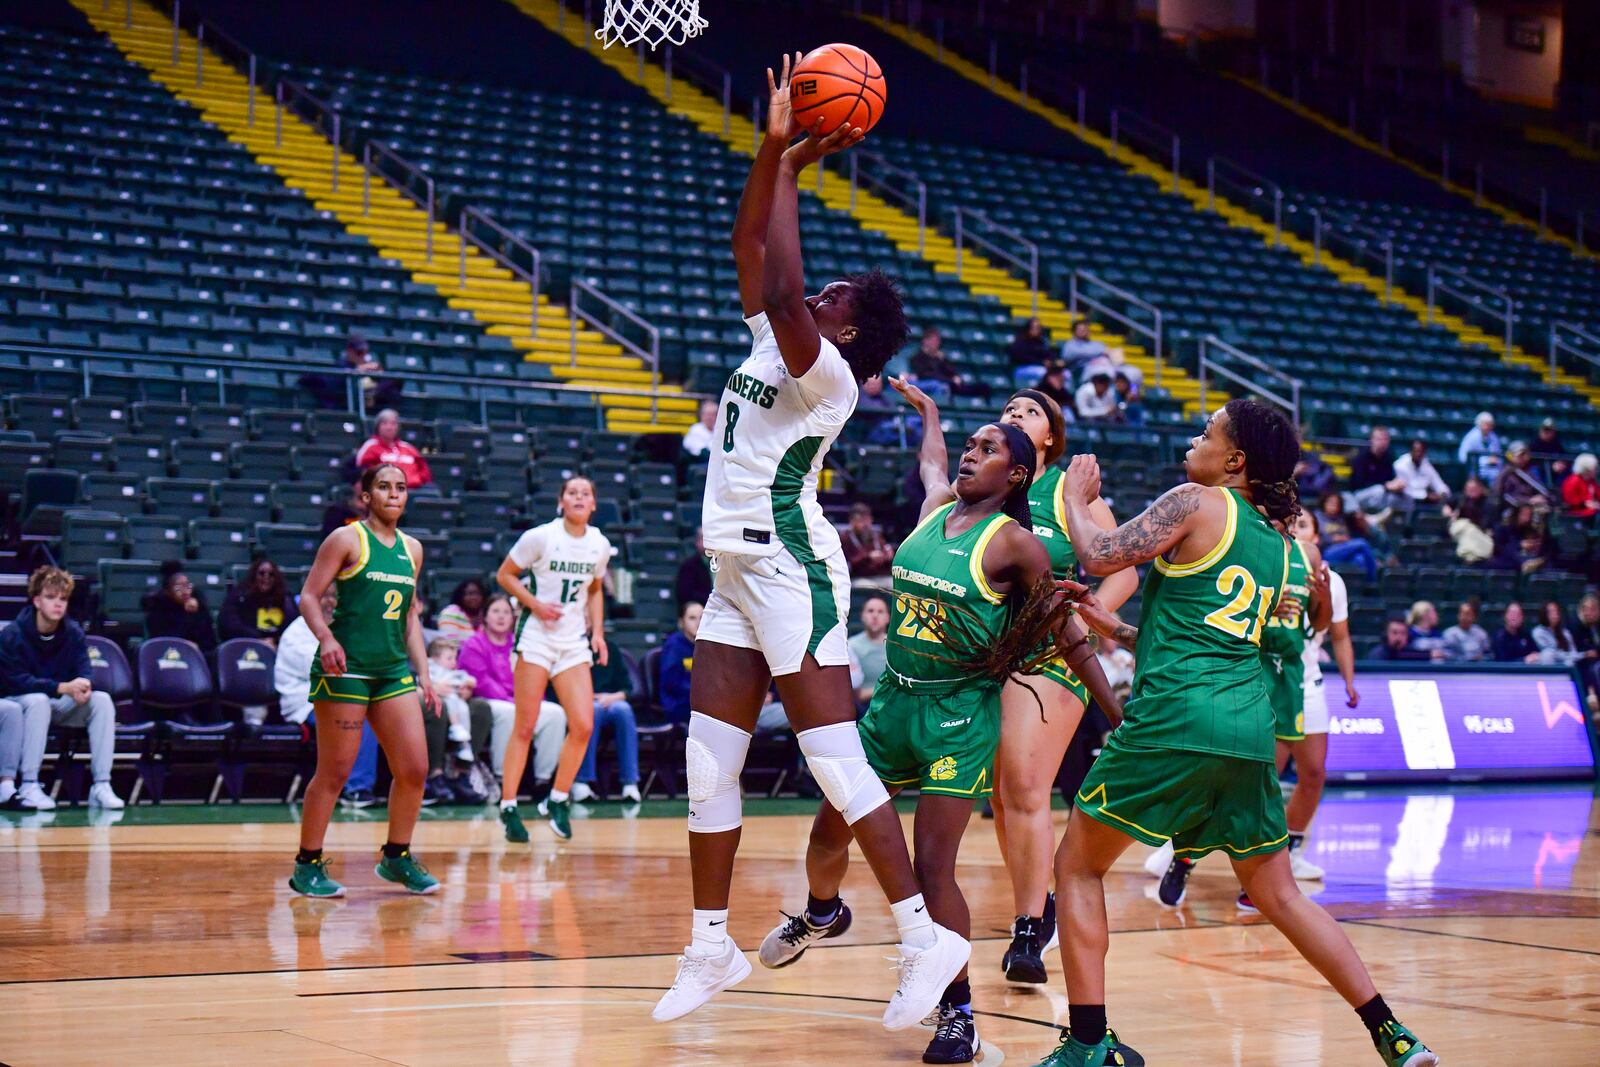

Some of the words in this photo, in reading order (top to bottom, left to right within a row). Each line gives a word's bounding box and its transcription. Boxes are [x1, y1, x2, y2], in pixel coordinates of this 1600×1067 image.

[726, 372, 779, 410] IDERS
[723, 401, 740, 453] 8
[382, 589, 403, 620] 2
[561, 579, 584, 603] 12
[1204, 565, 1275, 648] 21
[896, 592, 947, 644] 22
